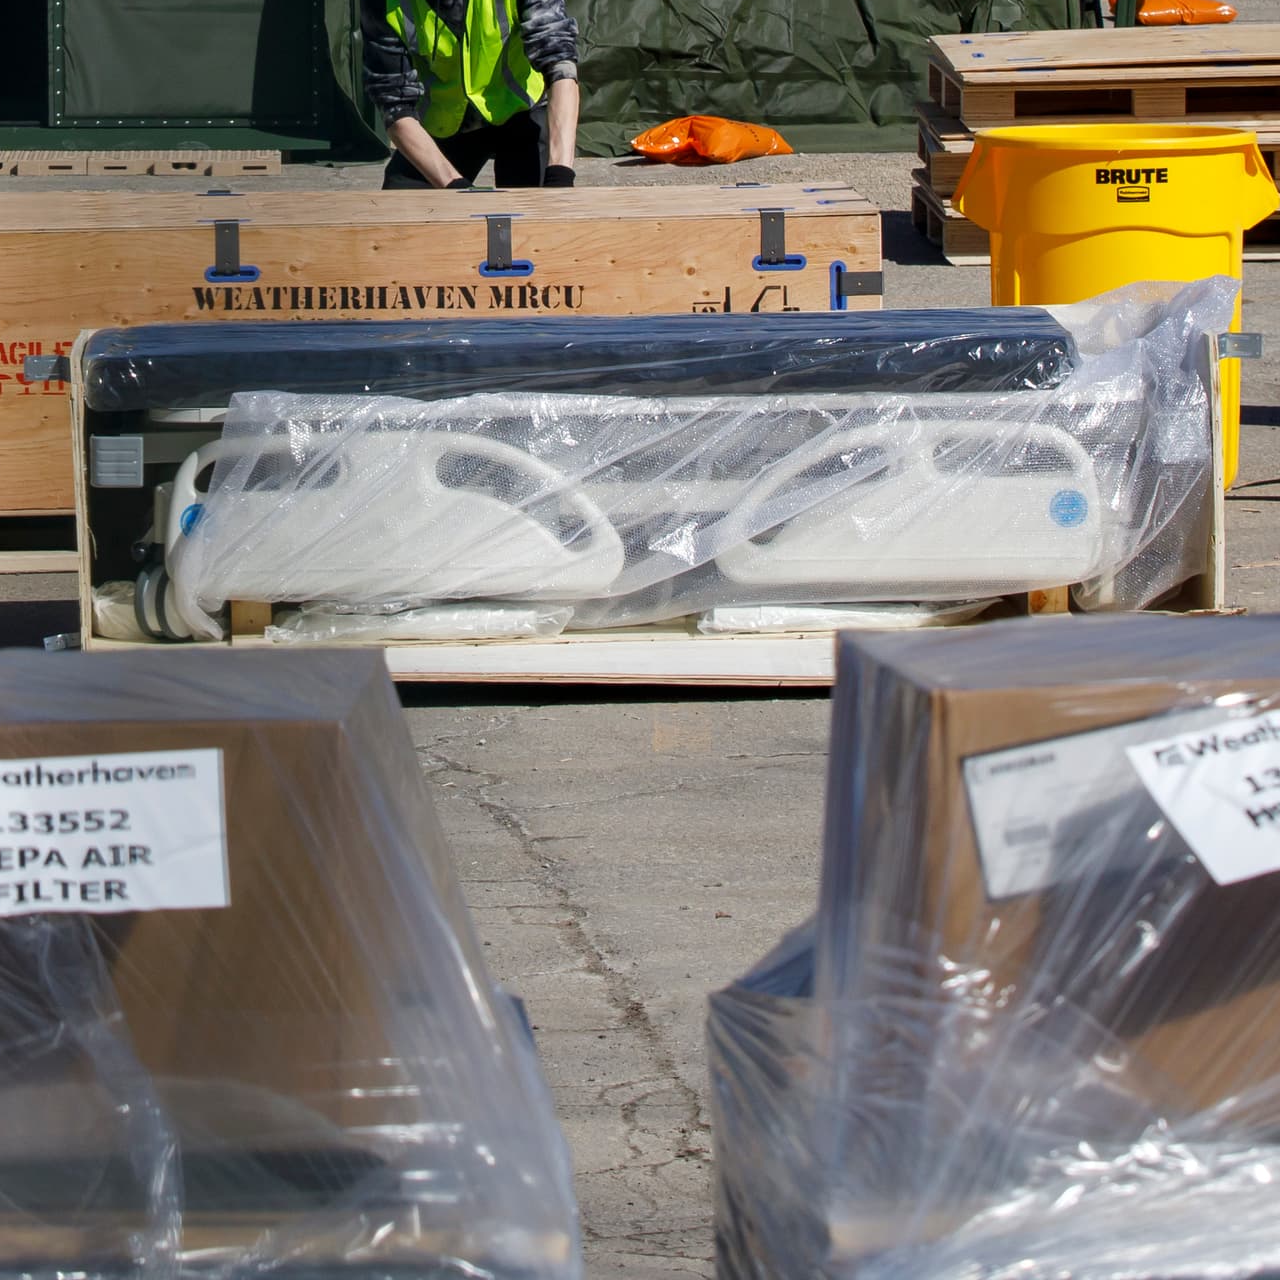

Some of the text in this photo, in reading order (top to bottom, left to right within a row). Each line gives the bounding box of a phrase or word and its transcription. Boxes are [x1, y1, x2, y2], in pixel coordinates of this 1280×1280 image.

[1095, 168, 1168, 184] BRUTE
[192, 285, 584, 311] WEATHERHAVEN MRCU
[81, 844, 154, 868] AIR
